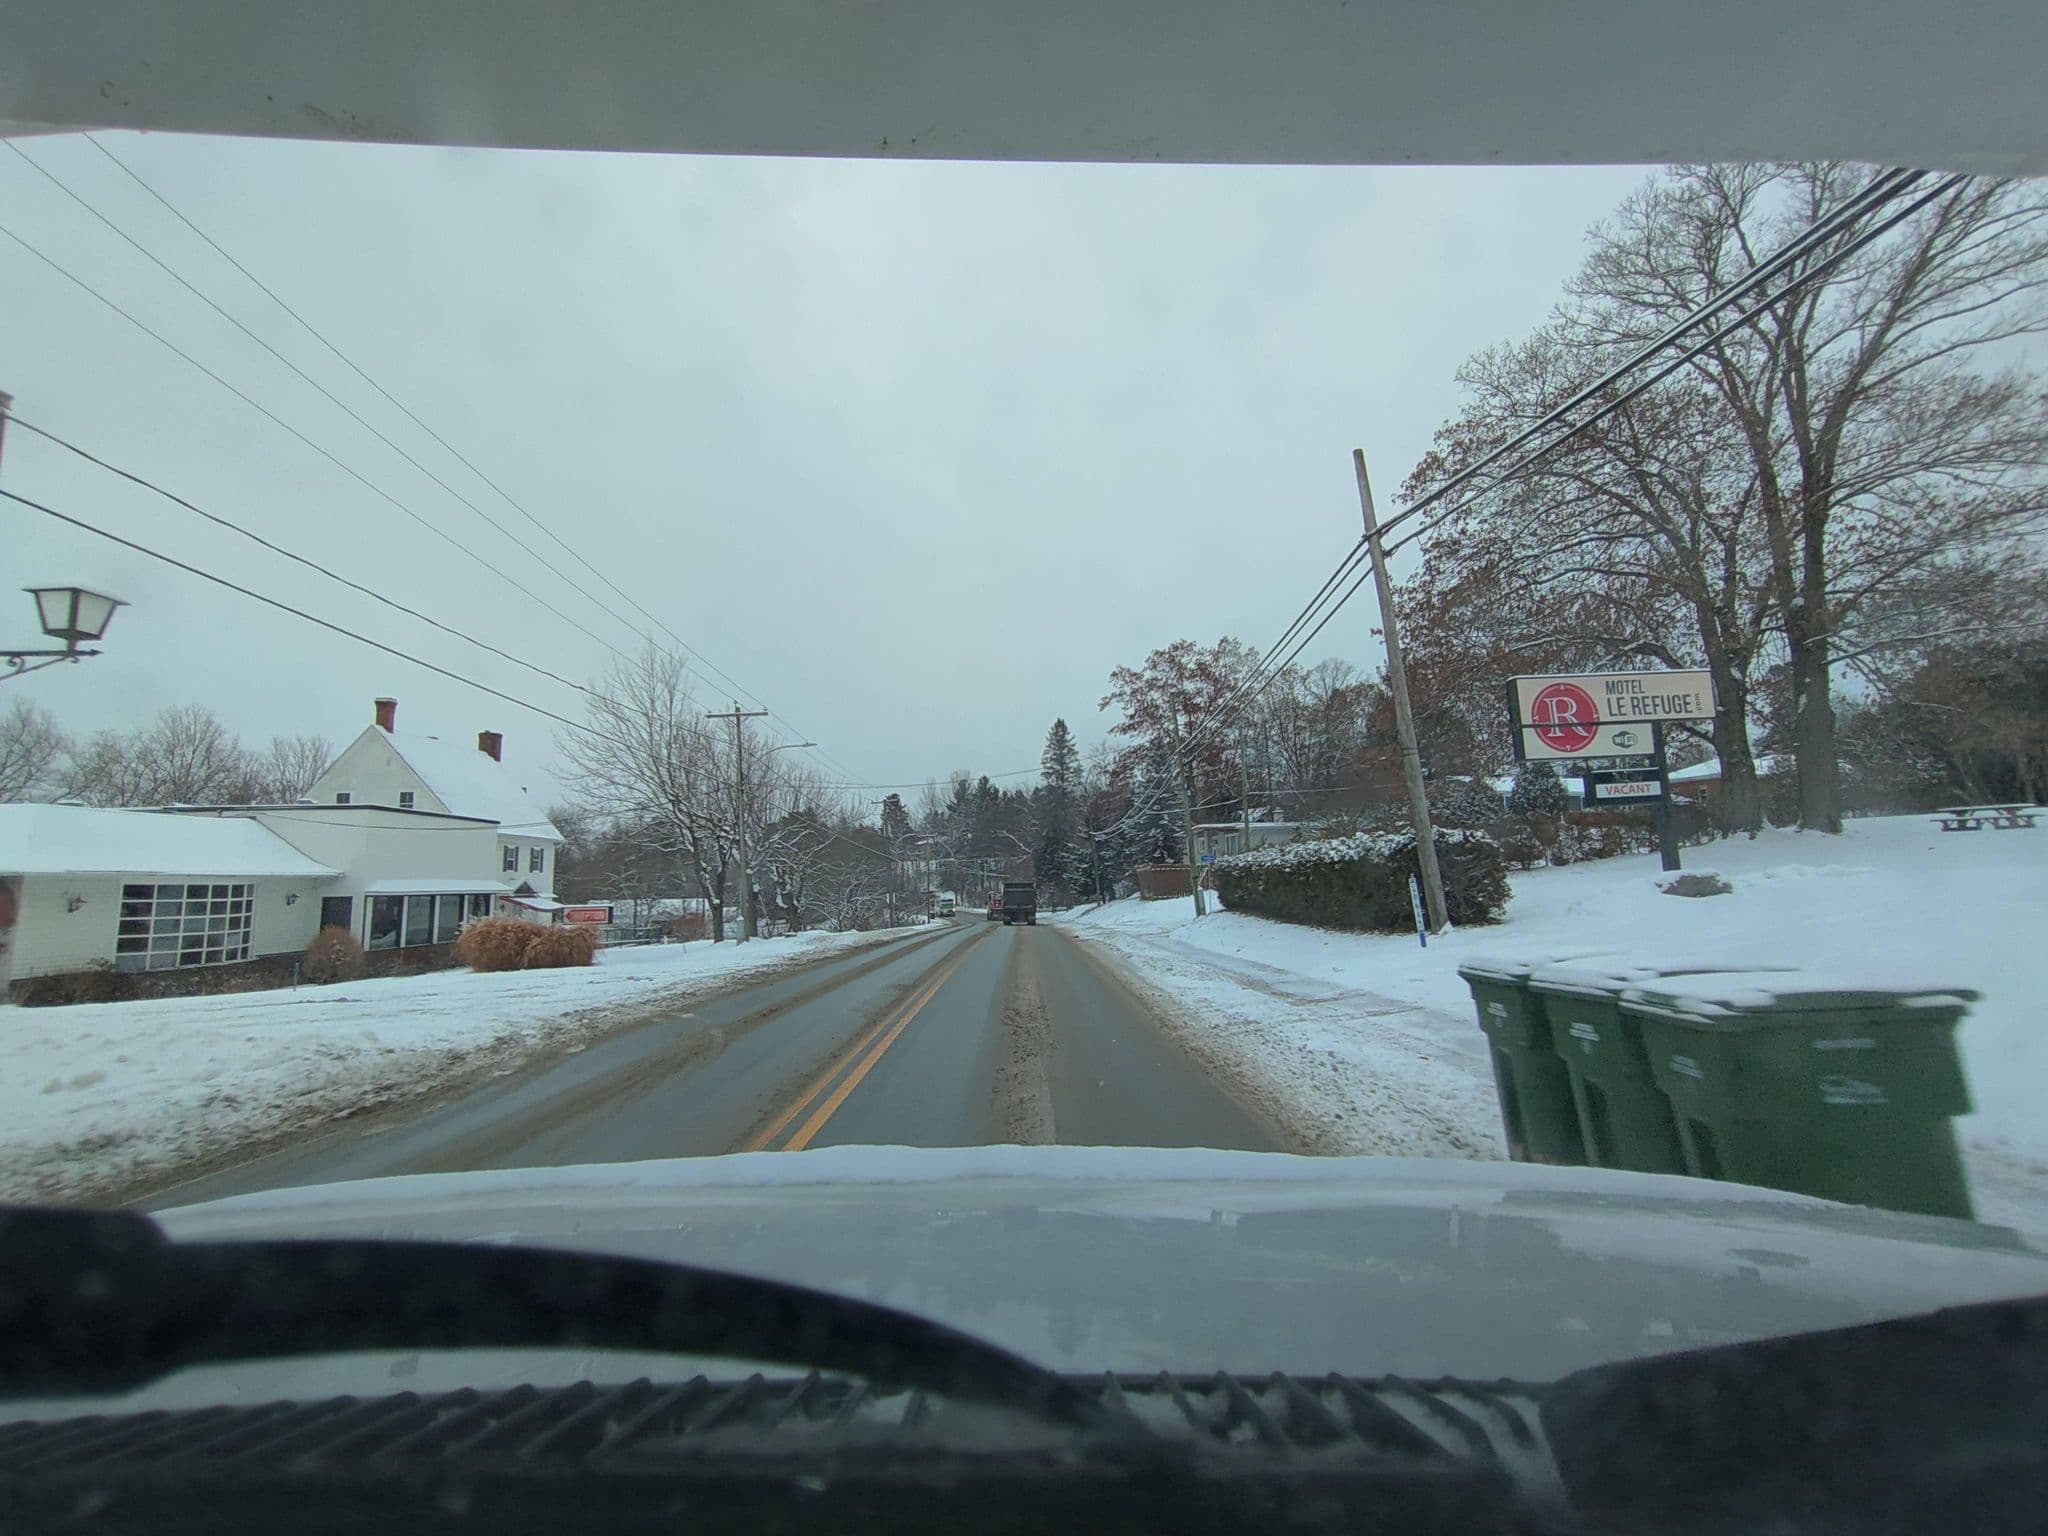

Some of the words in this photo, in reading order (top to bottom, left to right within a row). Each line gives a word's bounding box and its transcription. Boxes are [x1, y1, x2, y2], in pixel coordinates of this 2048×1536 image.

[1605, 679, 1645, 695] MOTEL
[1607, 697, 1626, 717] LE
[1631, 694, 1692, 716] REFUGE
[1543, 697, 1589, 737] R
[1605, 784, 1652, 796] VACANT
